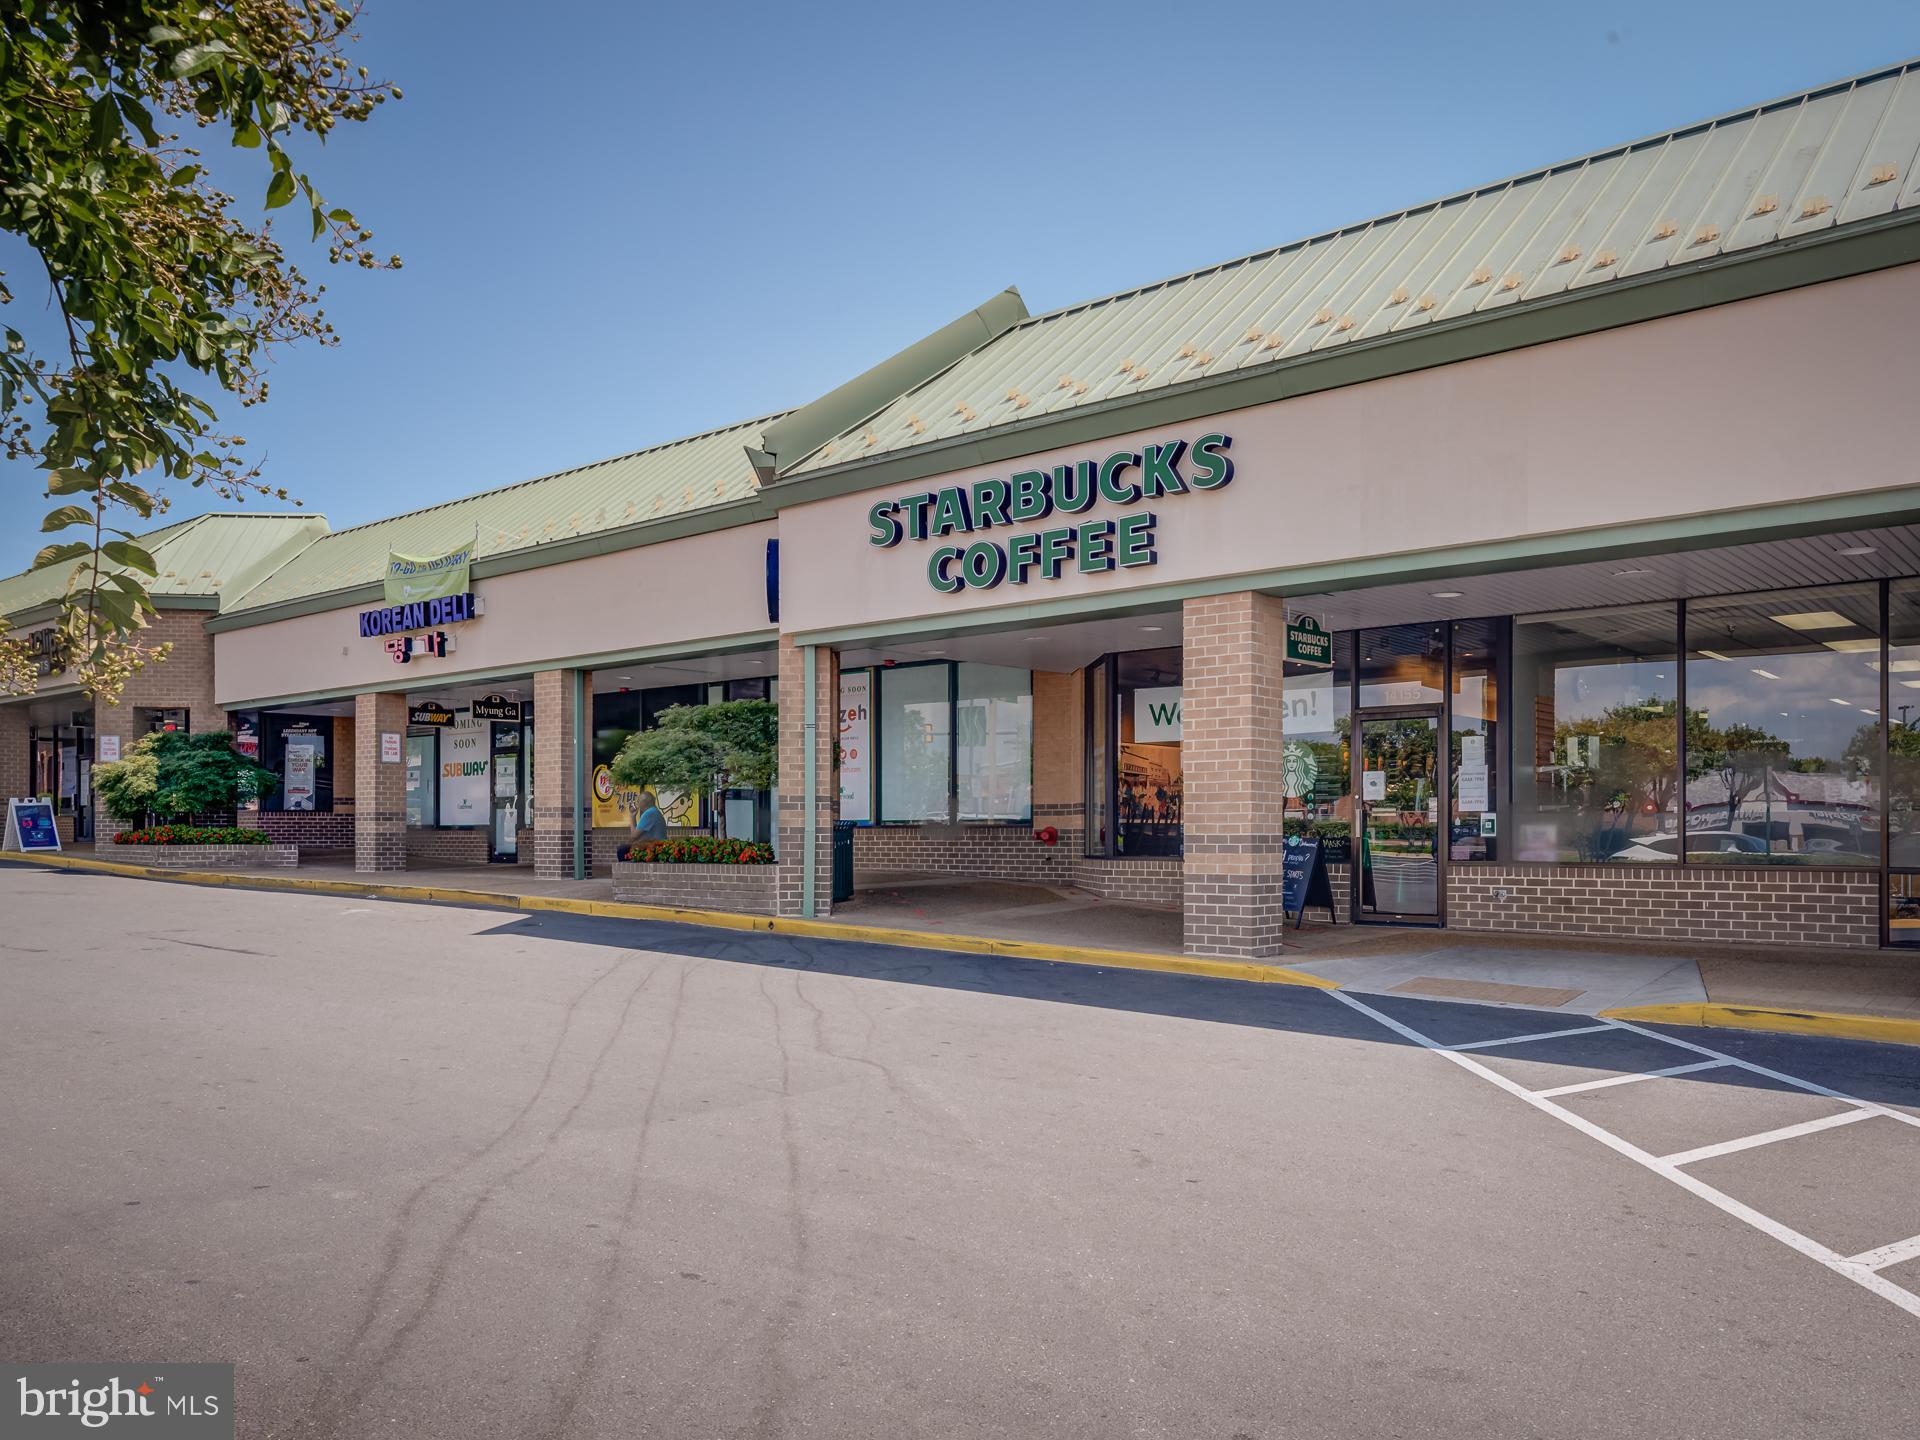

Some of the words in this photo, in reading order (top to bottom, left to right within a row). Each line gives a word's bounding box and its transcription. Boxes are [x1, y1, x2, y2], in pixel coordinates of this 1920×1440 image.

[869, 432, 1234, 548] STARBUCKS
[927, 511, 1158, 594] COFFEE
[360, 601, 430, 637] KOREAN
[429, 593, 474, 626] DELI
[384, 631, 446, 663] 명가
[1290, 630, 1329, 647] STARBUCKS
[1297, 643, 1322, 657] COFFEE
[847, 685, 867, 694] SOON
[412, 712, 452, 723] SUBWAY
[475, 705, 503, 717] Myung
[505, 707, 516, 716] Ga
[1148, 702, 1181, 727] W
[449, 719, 483, 731] OMING
[453, 738, 477, 749] SOON
[442, 760, 489, 778] SUBWAY
